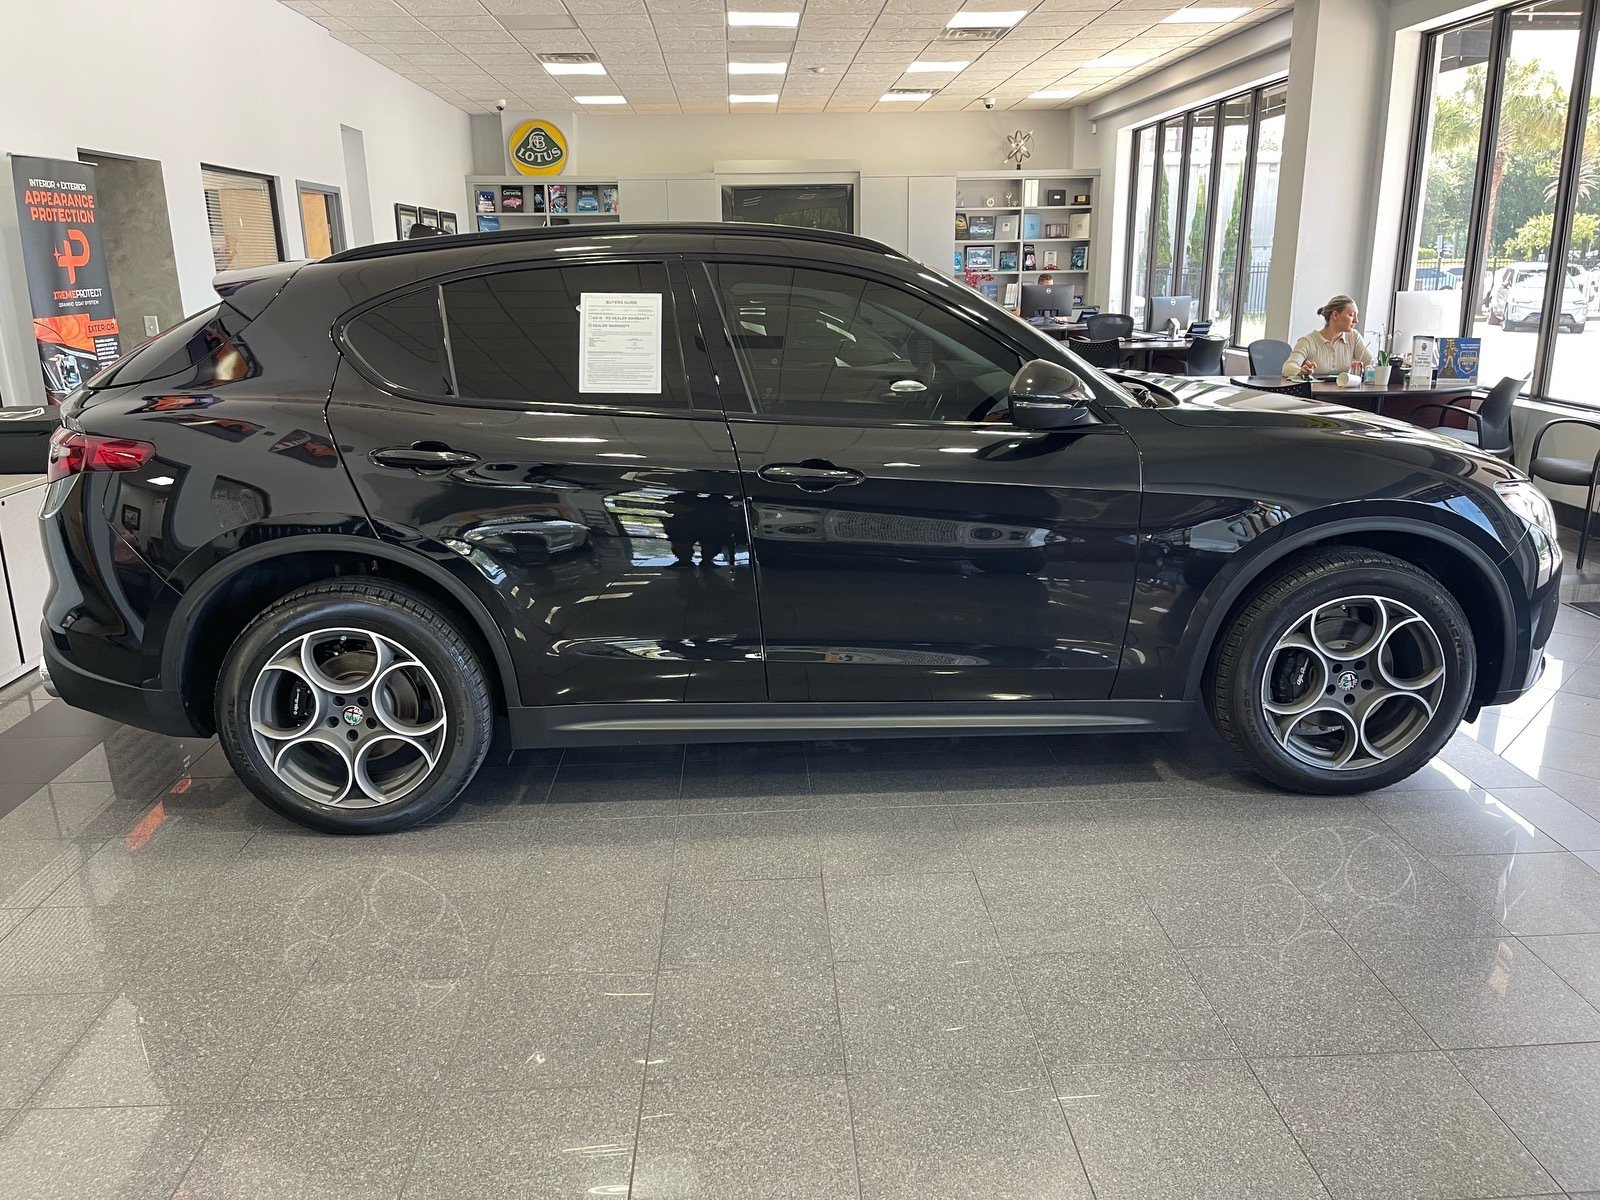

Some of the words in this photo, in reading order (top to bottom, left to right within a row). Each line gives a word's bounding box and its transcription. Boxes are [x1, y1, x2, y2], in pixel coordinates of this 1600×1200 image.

[517, 147, 561, 163] LOTUS
[28, 178, 56, 189] INTERIOR
[60, 181, 87, 191] EXTERIOR
[24, 190, 95, 208] APPEARANCE
[30, 207, 95, 223] PROTECTION
